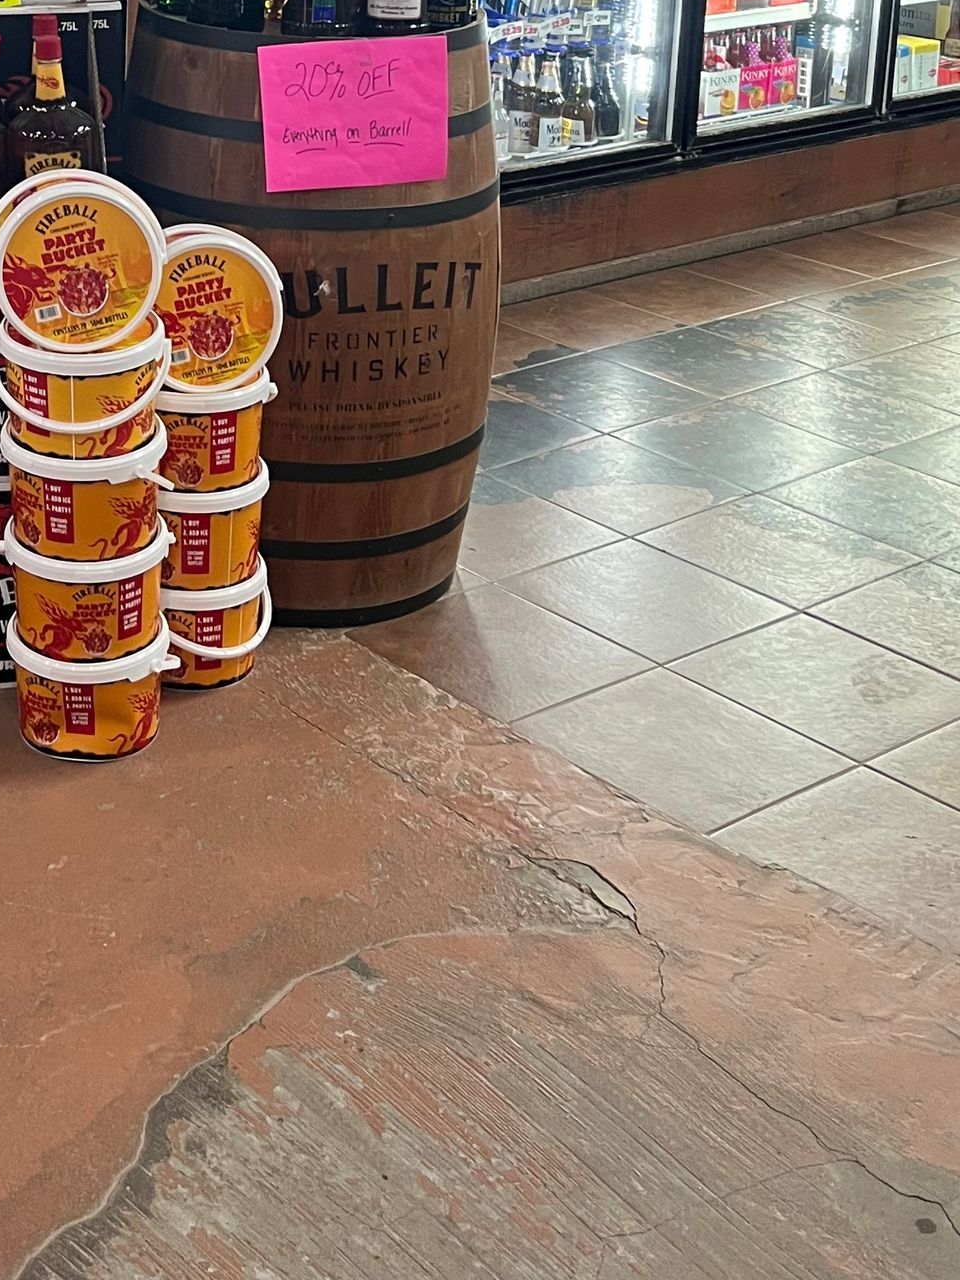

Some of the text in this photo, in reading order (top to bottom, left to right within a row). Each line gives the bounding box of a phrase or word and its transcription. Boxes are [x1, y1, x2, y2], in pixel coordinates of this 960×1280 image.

[283, 59, 400, 102] 20% OFF
[709, 73, 740, 87] KINKY
[741, 69, 770, 82] KINKY
[773, 65, 797, 78] KINKY
[282, 117, 412, 145] Everything on Barrell
[29, 157, 77, 175] FIREBALL
[35, 204, 98, 236] FIREBALL
[43, 226, 96, 251] PARTY
[41, 238, 106, 266] BUCKET
[168, 254, 227, 283] FIREBALL
[174, 287, 232, 312] BUCKET
[176, 276, 225, 298] PARTY
[280, 261, 482, 320] ULLEIT
[53, 311, 129, 337] CONTAINS BOTTLES
[308, 324, 439, 350] FRONTIER
[288, 346, 450, 384] WHISKEY
[336, 400, 374, 412] DRINK
[50, 485, 62, 493] BUY
[51, 495, 62, 504] ADD
[72, 584, 116, 602] FIREBALL
